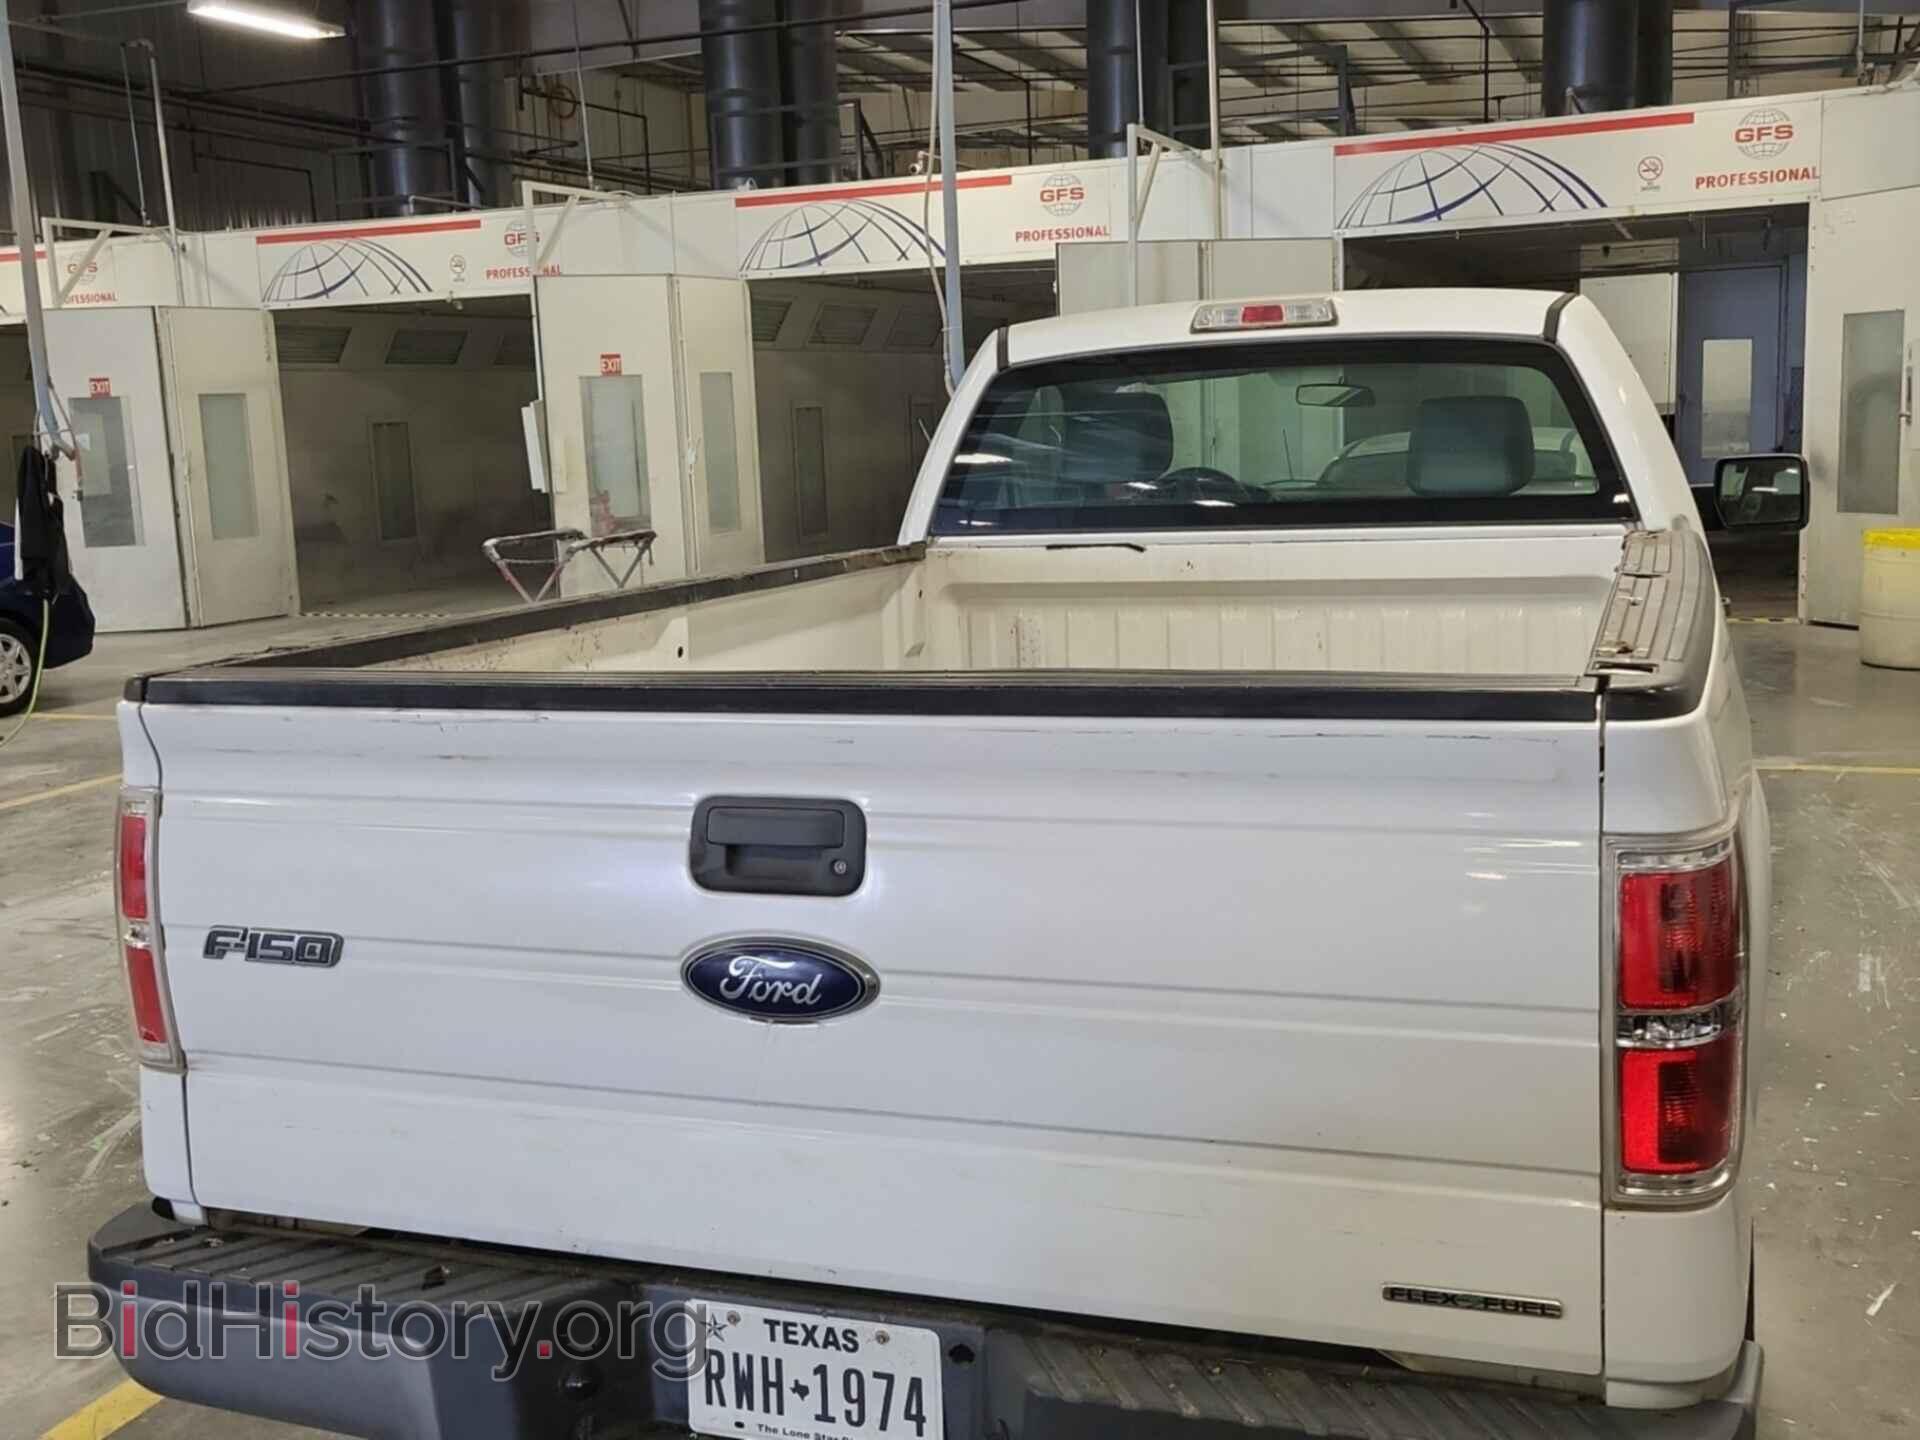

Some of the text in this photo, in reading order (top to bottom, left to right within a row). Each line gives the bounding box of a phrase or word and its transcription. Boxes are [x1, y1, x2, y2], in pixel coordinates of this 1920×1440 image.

[1735, 124, 1794, 143] GFS
[1695, 166, 1821, 190] PROFESSIONAL
[1040, 187, 1085, 202] GFS
[1015, 225, 1111, 242] PROFESSIONAL
[67, 261, 98, 274] GS
[485, 264, 562, 280] PROFESSNAL
[600, 358, 622, 372] EXIT
[89, 381, 111, 393] EXIT
[203, 925, 344, 968] F-150
[719, 955, 823, 1005] Ford
[1390, 1286, 1562, 1318] FLEX FUEL
[763, 1317, 860, 1354] TEXAS
[704, 1348, 927, 1438] RWH 1974
[757, 1423, 779, 1435] The
[782, 1427, 811, 1440] Lone
